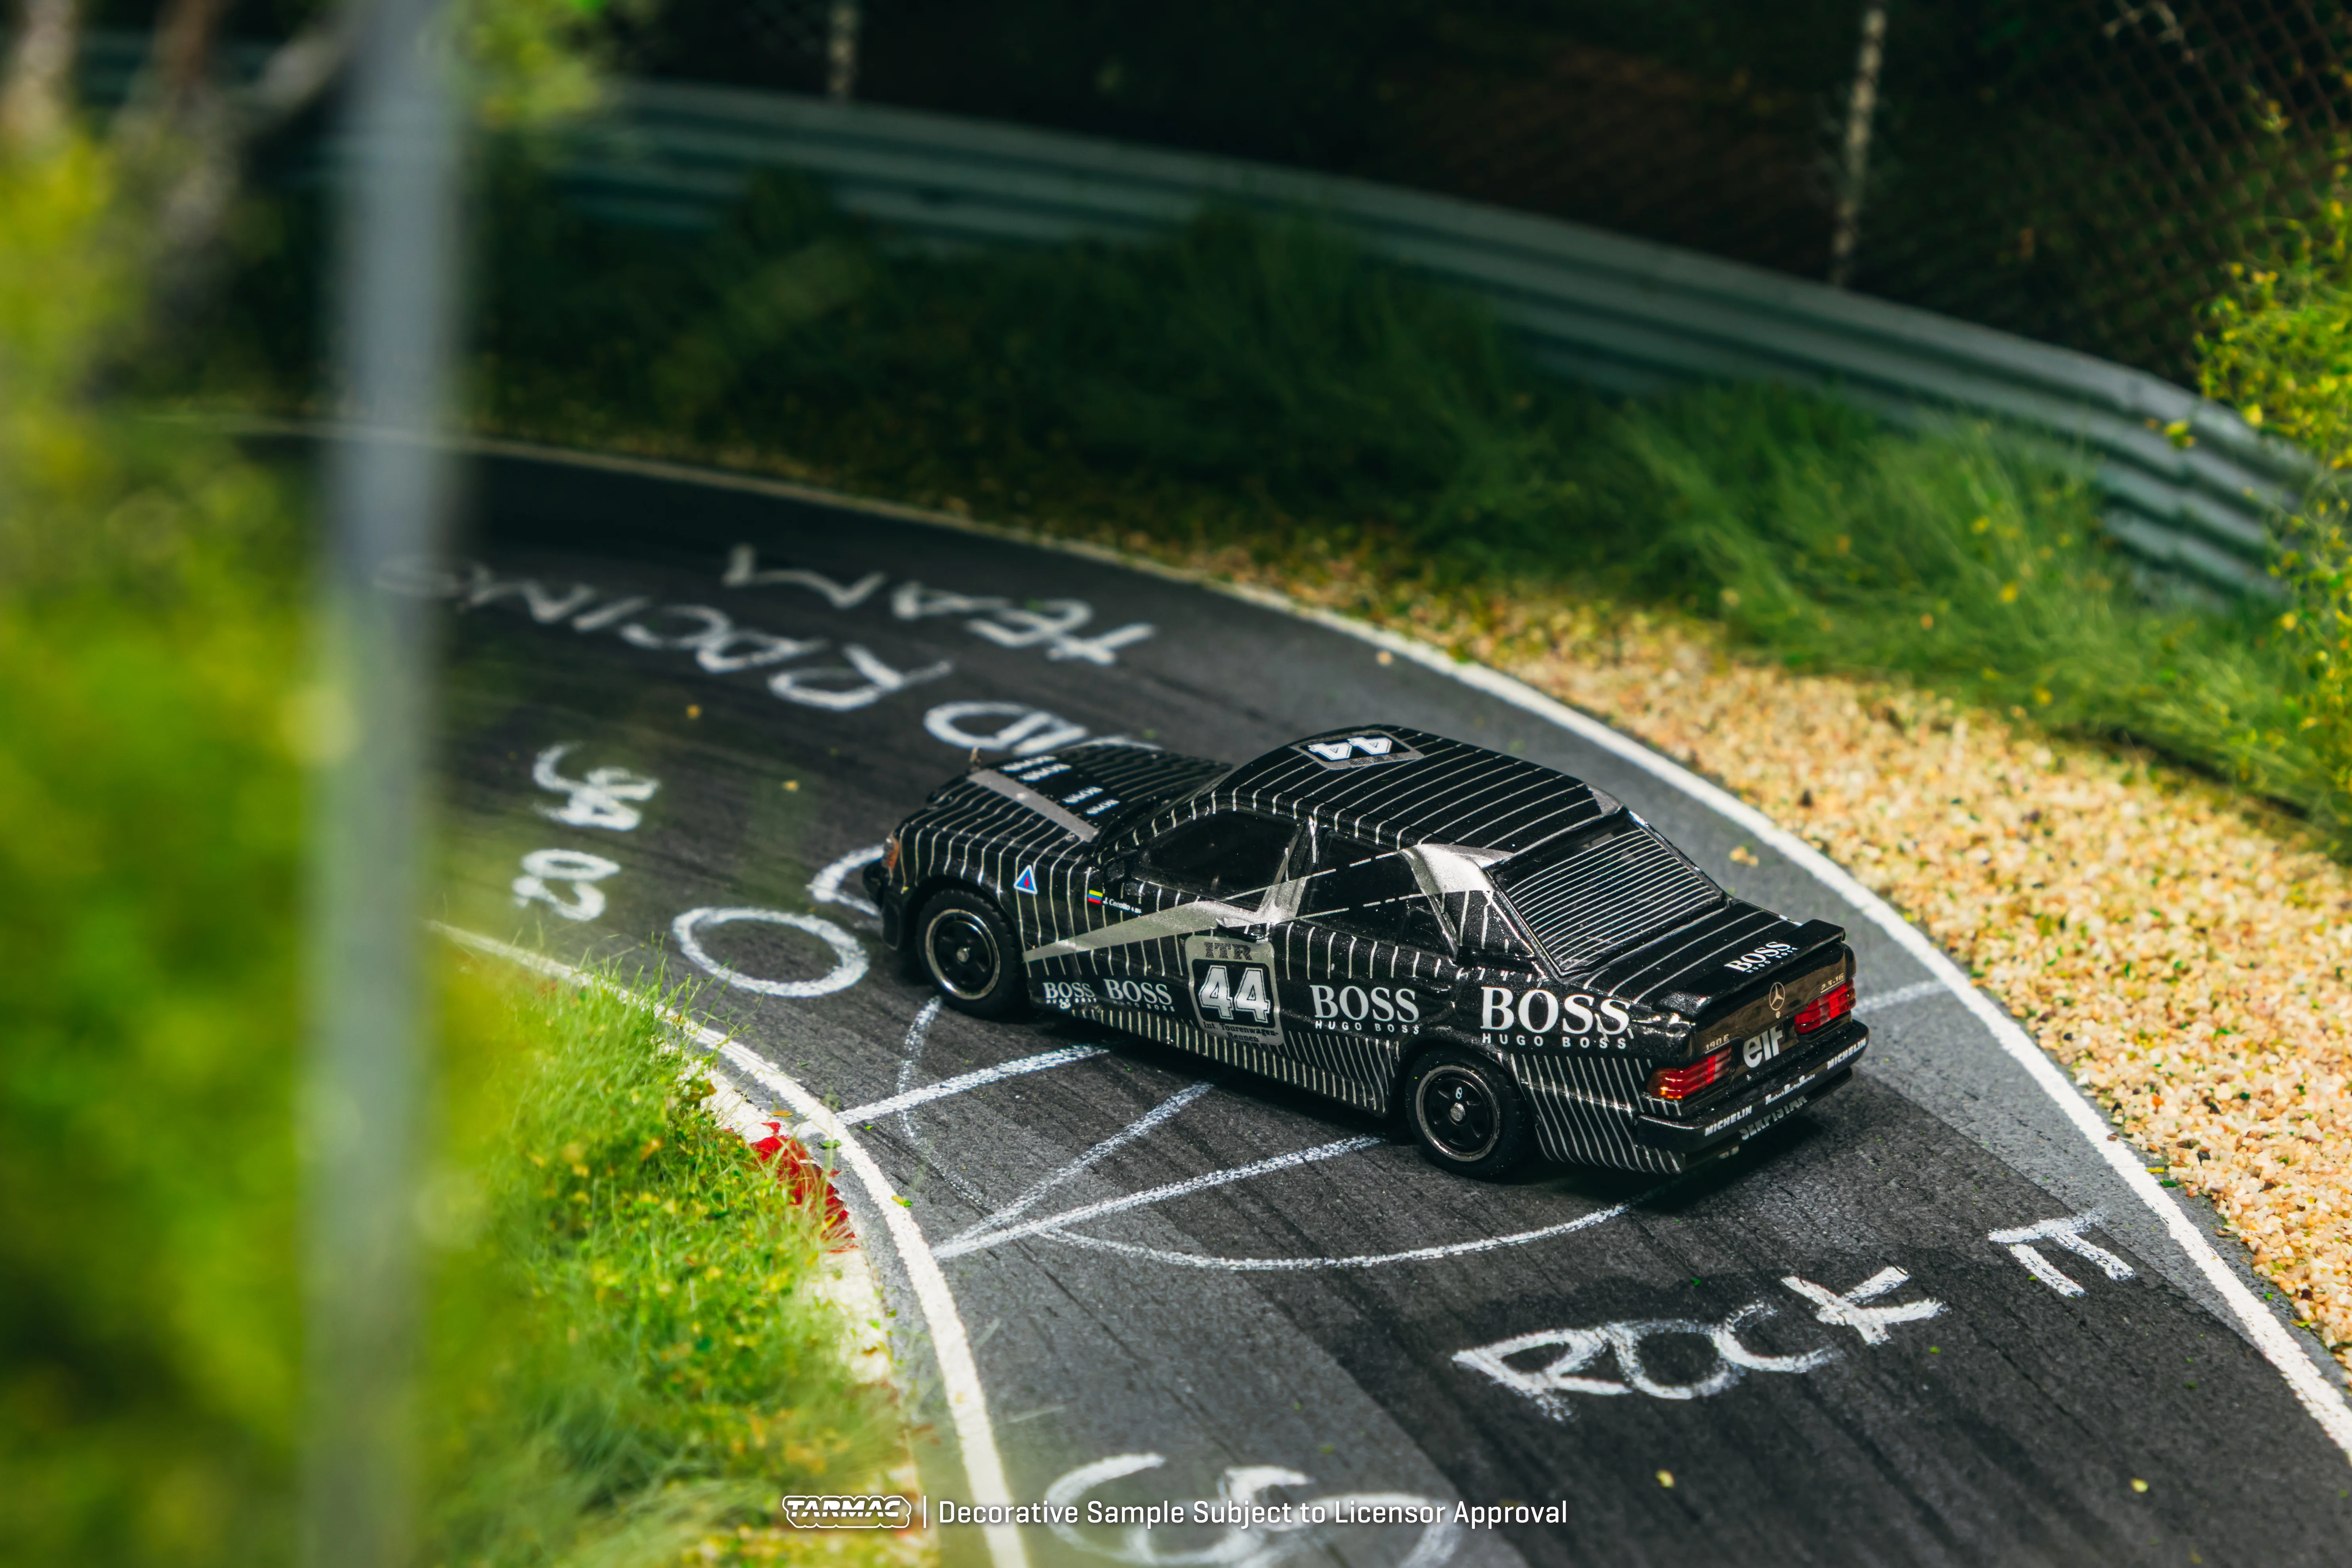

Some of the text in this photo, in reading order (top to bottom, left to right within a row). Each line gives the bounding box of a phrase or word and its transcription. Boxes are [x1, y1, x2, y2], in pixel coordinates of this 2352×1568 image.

[721, 543, 1155, 664] TEAM
[1308, 736, 1393, 761] 44
[1204, 942, 1253, 961] ITR
[1724, 941, 1791, 972] BOSS
[1746, 960, 1771, 973] HUGO
[1043, 982, 1095, 998] BOSS
[1103, 979, 1173, 1005] BOSS
[1198, 965, 1271, 1023] 44
[1112, 1000, 1175, 1012] HUGO BOSS
[1309, 984, 1419, 1023] BOSS
[1480, 986, 1631, 1035] BOSS
[1203, 1021, 1218, 1030] Int.
[1315, 1020, 1419, 1035] HUGO BOSS
[1482, 1033, 1626, 1049] HUGO BOSS
[1743, 1025, 1784, 1068] elf
[1827, 1038, 1867, 1070] MICHELIN
[1705, 1105, 1752, 1137] MICHELIN
